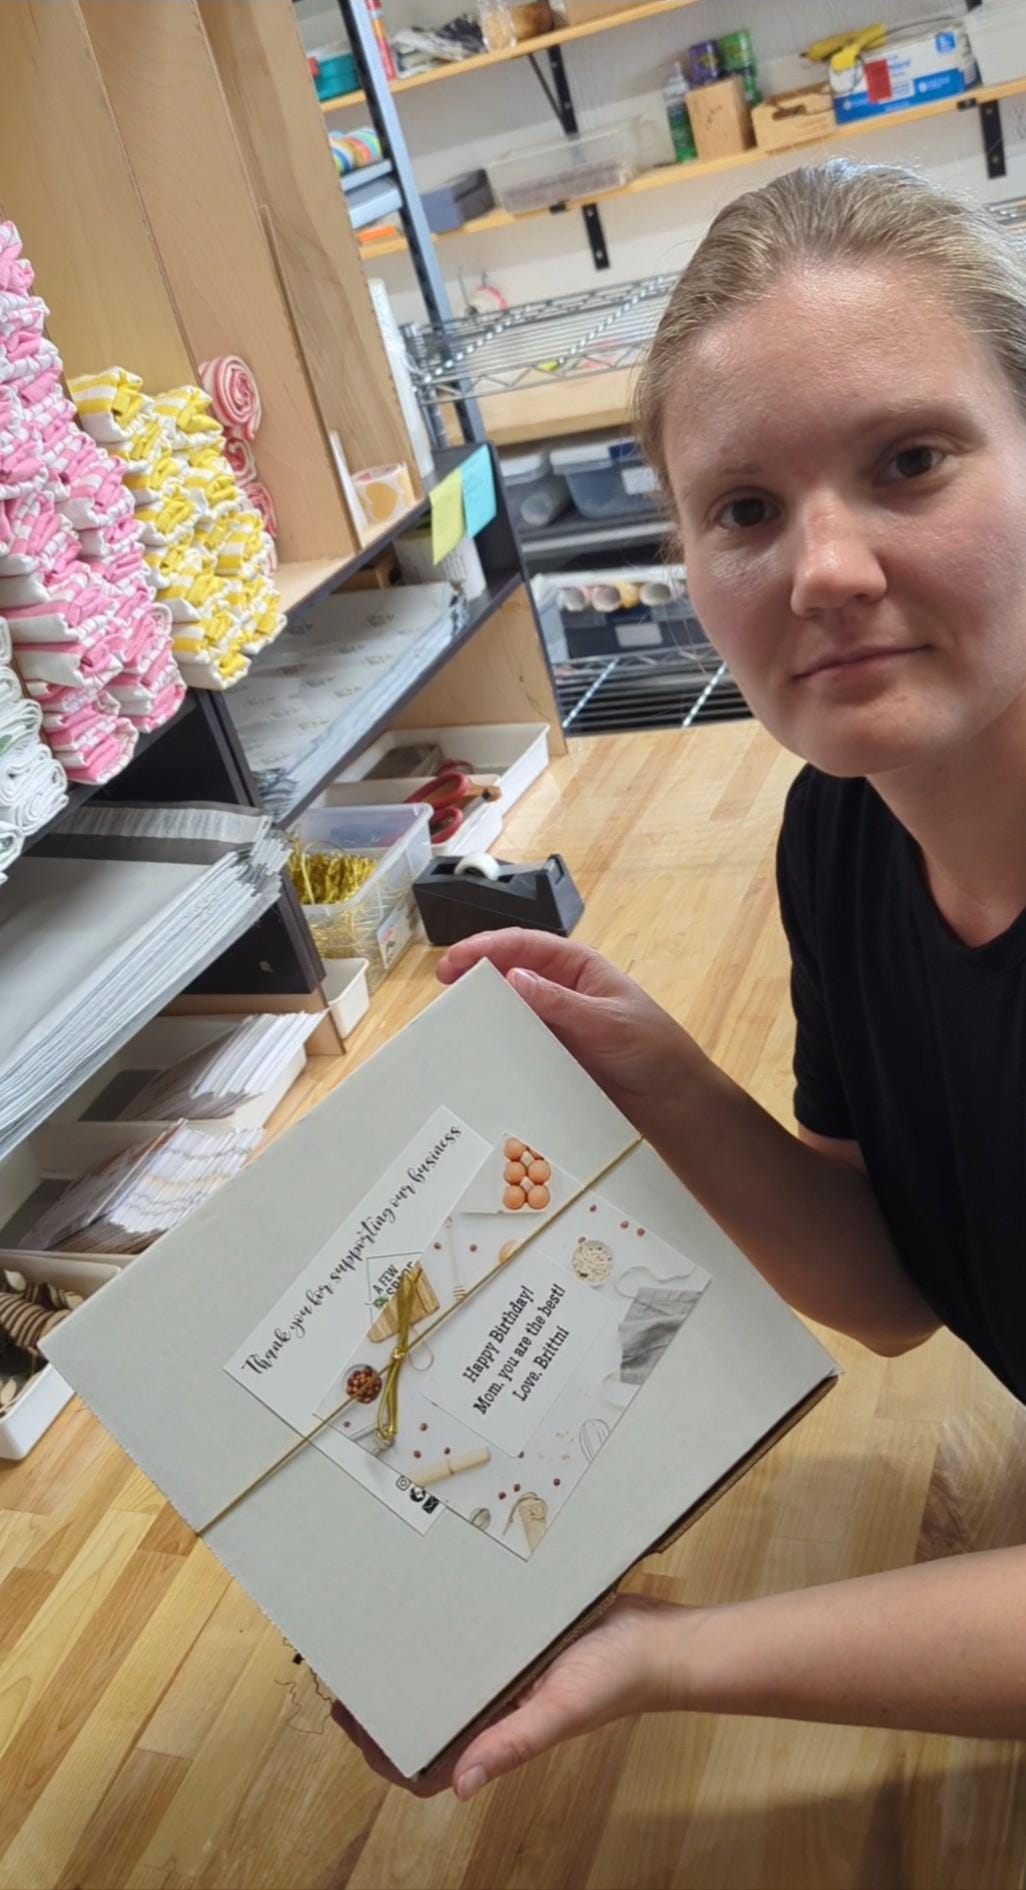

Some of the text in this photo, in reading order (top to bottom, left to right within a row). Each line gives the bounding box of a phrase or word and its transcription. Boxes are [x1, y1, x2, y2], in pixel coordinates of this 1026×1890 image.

[241, 1126, 462, 1374] Thank you for supporting our business
[372, 1264, 399, 1295] A FEW
[462, 1285, 534, 1383] Happy Birthday!
[498, 1357, 520, 1382] you
[514, 1335, 532, 1358] are
[524, 1315, 546, 1337] the
[537, 1283, 566, 1318] best!
[533, 1325, 569, 1370] Brittni
